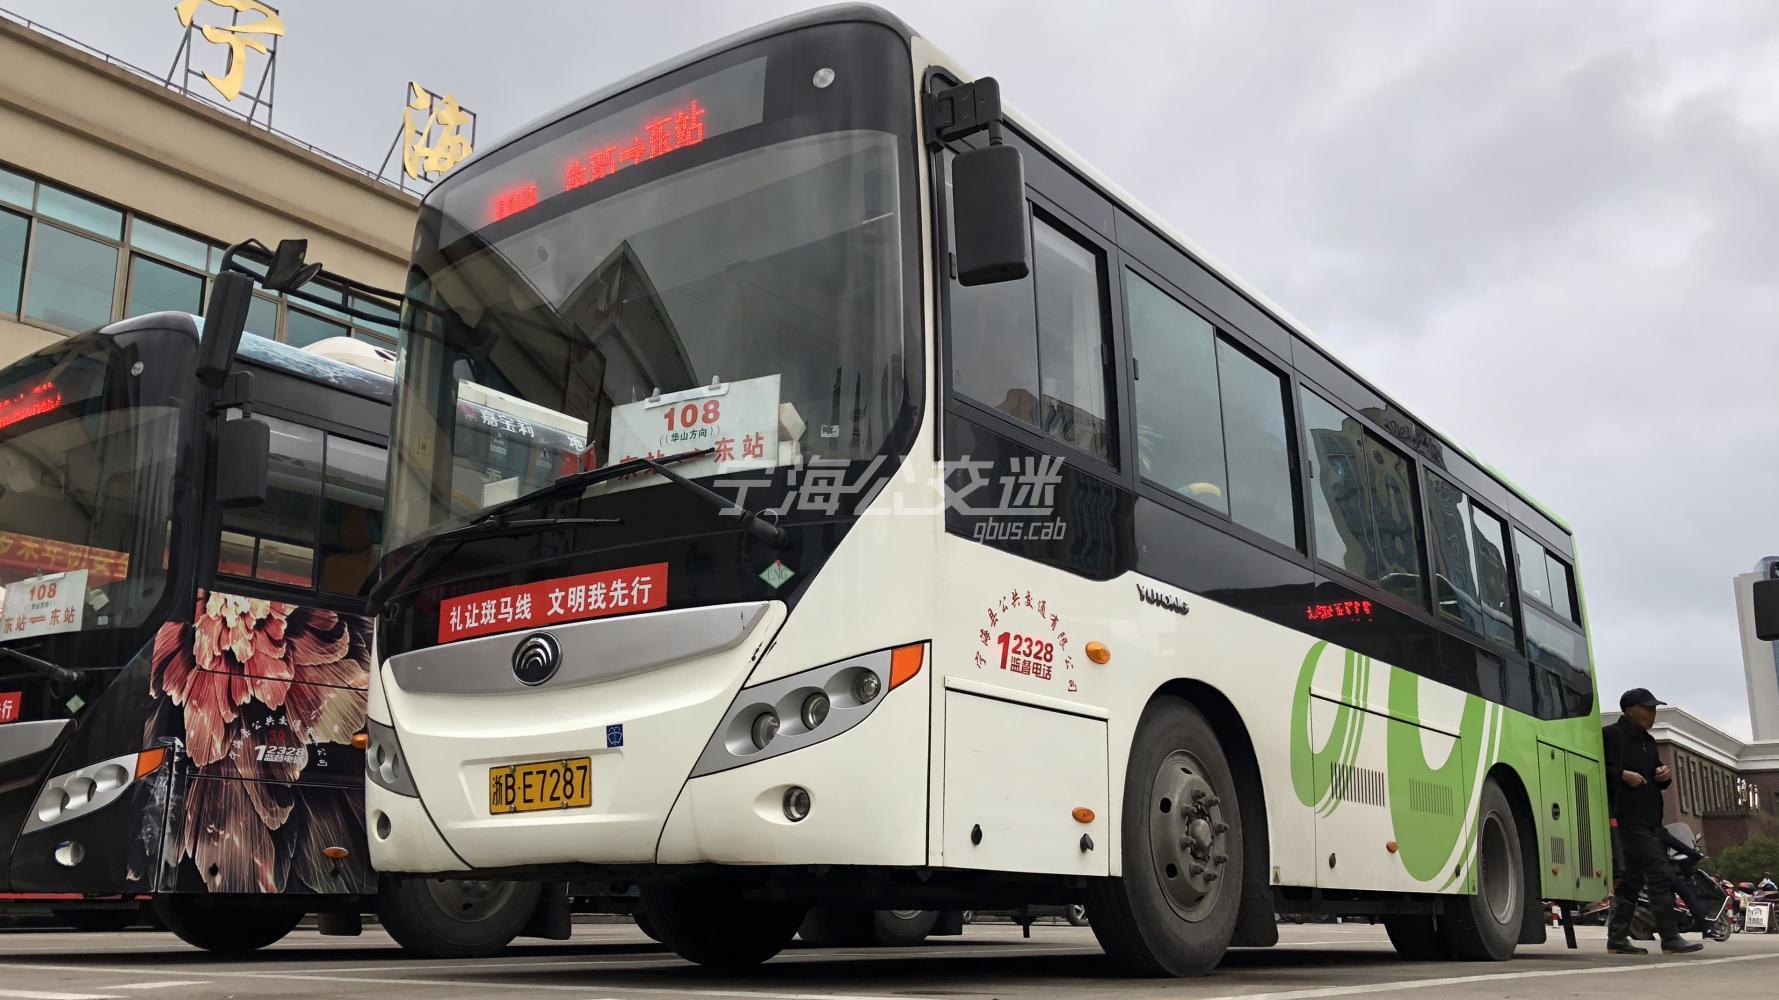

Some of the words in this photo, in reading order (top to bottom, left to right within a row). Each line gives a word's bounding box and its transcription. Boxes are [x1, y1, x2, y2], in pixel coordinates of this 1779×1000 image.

[481, 410, 535, 438] 嘉宝利
[664, 400, 720, 431] 108
[714, 432, 764, 465] 东站
[29, 582, 58, 601] 108
[449, 593, 532, 632] 礼让斑马线
[547, 576, 652, 616] 文明我先行
[3, 613, 26, 634] 东站
[49, 606, 76, 626] 东站
[997, 631, 1055, 670] 12328
[1010, 655, 1053, 681] 监督电话
[254, 744, 305, 761] 12328
